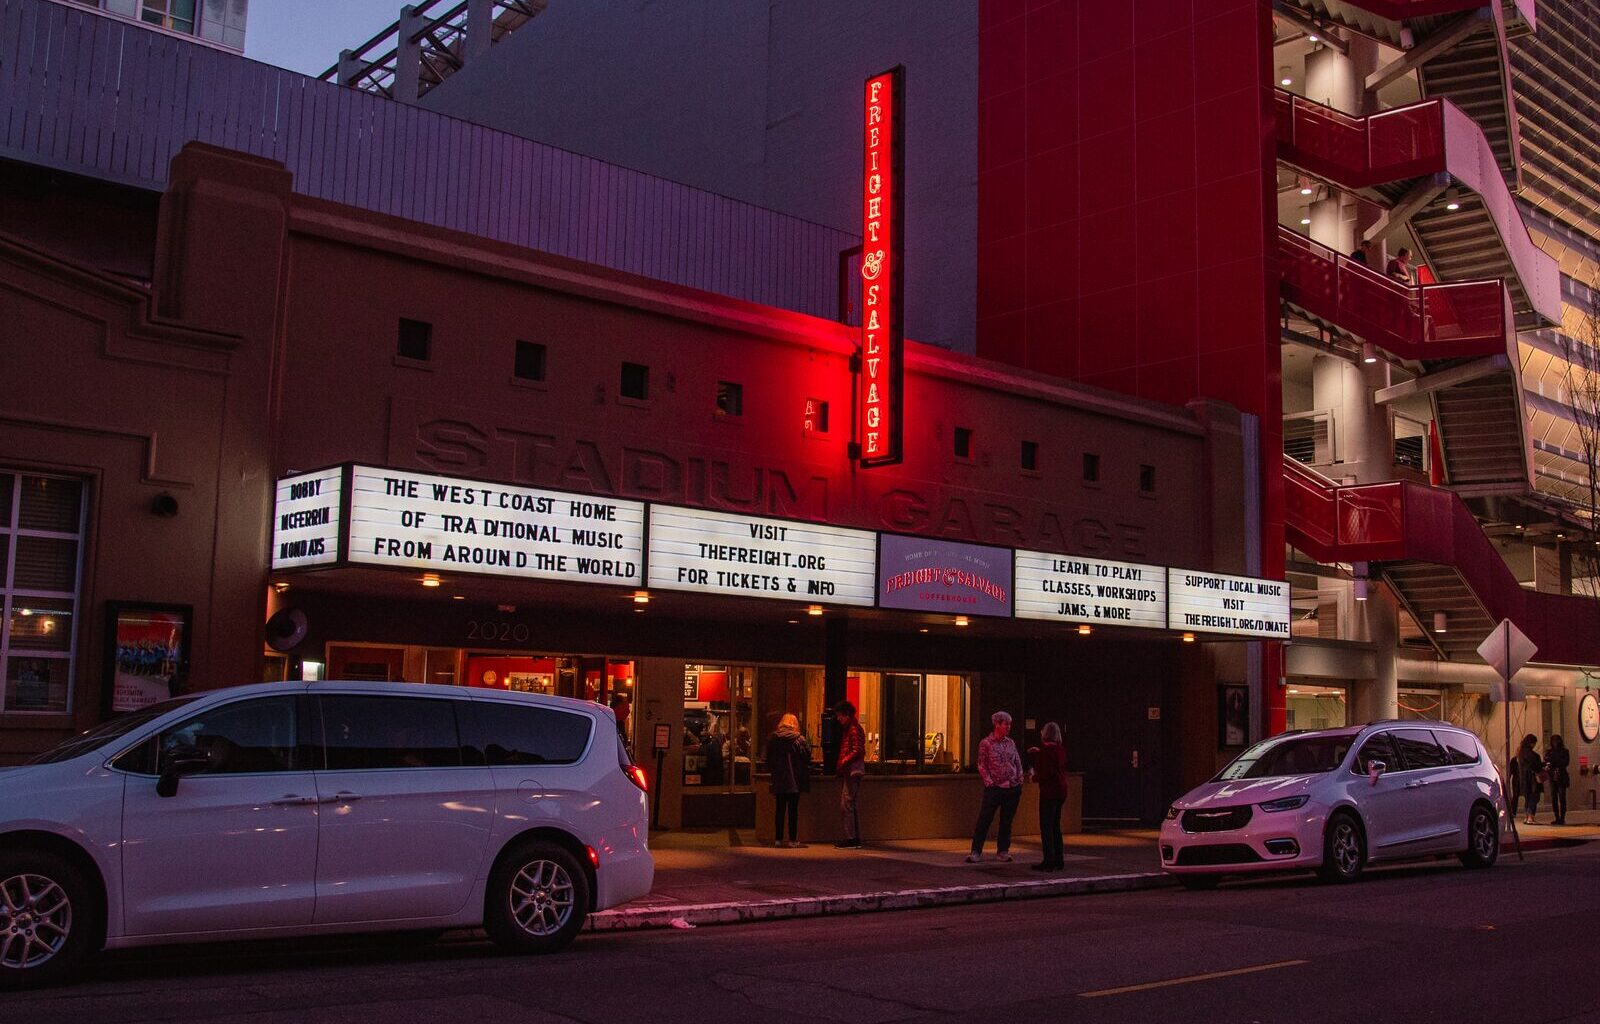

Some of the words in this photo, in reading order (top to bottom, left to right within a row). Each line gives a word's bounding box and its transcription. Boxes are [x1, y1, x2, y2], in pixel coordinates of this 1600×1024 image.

[868, 81, 882, 242] FREIGHT
[862, 250, 885, 280] &
[867, 285, 881, 453] SALVAGE
[290, 479, 322, 500] BOBBY
[384, 477, 419, 499] THE
[432, 483, 493, 507] WEST
[500, 492, 555, 515] COAST
[569, 500, 617, 522] HOME
[414, 418, 830, 518] STADIUM
[880, 488, 1148, 557] GARAGE
[281, 507, 330, 530] MCFERRIN
[401, 510, 426, 529] OF
[441, 514, 561, 544] TRADITIONAL
[571, 529, 624, 550] MUSIC
[749, 523, 787, 542] VISIT
[374, 537, 432, 560] FROM
[443, 544, 527, 568] AROUND
[535, 553, 567, 572] THE
[577, 557, 636, 579] WORLD
[699, 542, 826, 571] THEFREIGHT.ORG
[1053, 559, 1089, 576] LEARN
[1095, 564, 1108, 577] TO
[1112, 566, 1142, 581] PLAY!
[678, 567, 708, 584] FOR
[717, 571, 780, 591] TICKETS
[787, 578, 797, 593] &
[807, 579, 835, 596] INFO
[886, 567, 941, 594] FREIGHT
[942, 567, 957, 587] &
[957, 570, 1006, 604] SALVAGE
[1042, 579, 1094, 598] CLASSES,
[1096, 585, 1157, 602] WORKSHOPS
[1185, 575, 1226, 590] SUPPORT
[1229, 580, 1255, 594] LOCAL
[1257, 583, 1281, 596] MUSIC
[1058, 603, 1090, 618] JAMS,
[1094, 605, 1101, 618] &
[1103, 606, 1131, 620] MORE
[1223, 598, 1245, 611] VISIT
[467, 620, 529, 642] 2020
